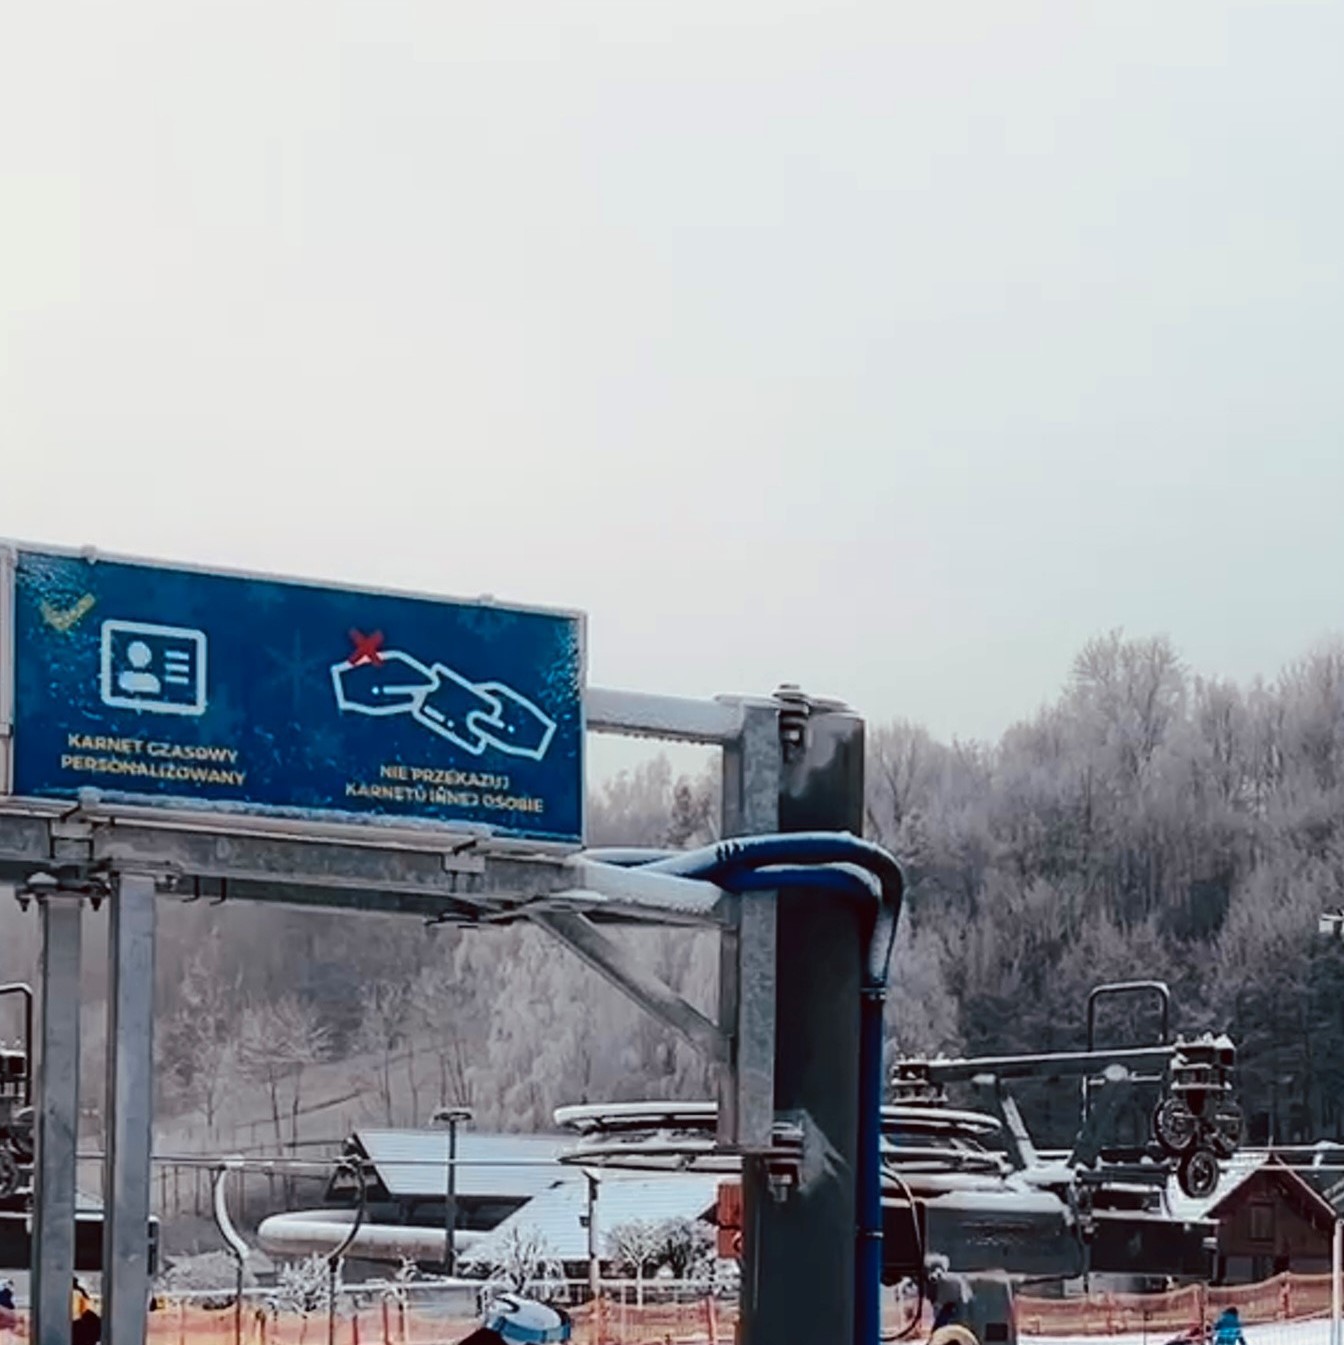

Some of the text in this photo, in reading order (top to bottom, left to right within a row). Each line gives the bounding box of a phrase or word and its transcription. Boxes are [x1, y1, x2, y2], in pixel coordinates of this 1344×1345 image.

[67, 733, 239, 764] KARNET CZASOWY
[60, 754, 248, 786] PERSONALIZOWANY
[379, 764, 510, 790] NIE PRZEKAZUJ
[345, 782, 428, 803] KARNETU
[481, 794, 545, 813] OSOBIE
